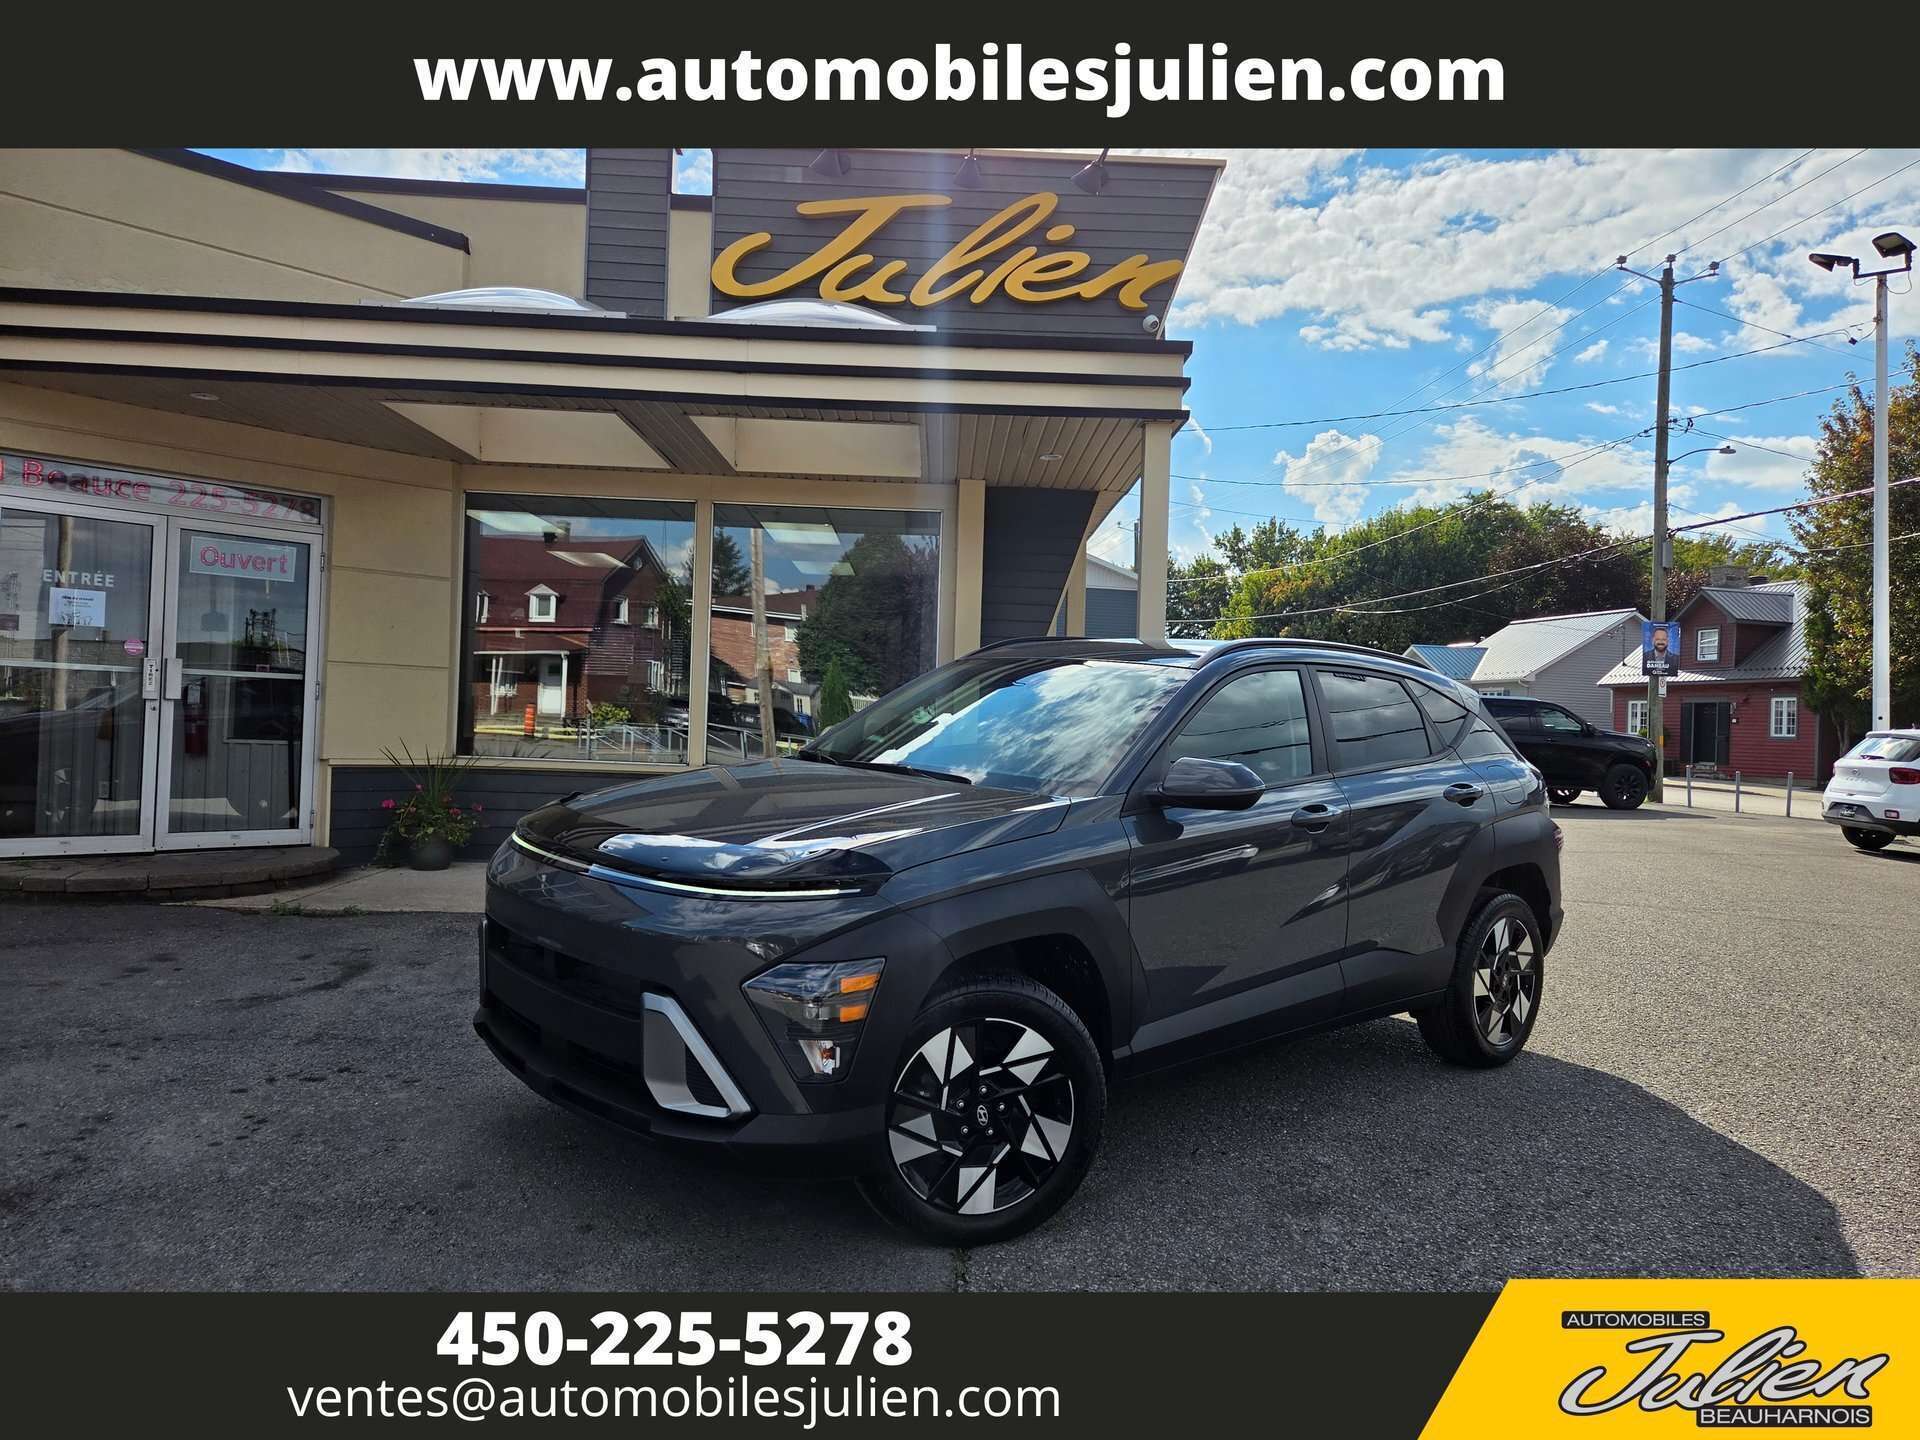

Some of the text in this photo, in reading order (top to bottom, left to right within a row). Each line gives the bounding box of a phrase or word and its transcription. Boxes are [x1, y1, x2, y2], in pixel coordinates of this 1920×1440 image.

[711, 192, 1183, 309] Julien
[22, 459, 151, 502] Beauce
[200, 545, 289, 574] Ouvert
[42, 569, 115, 588] ENTRÉE
